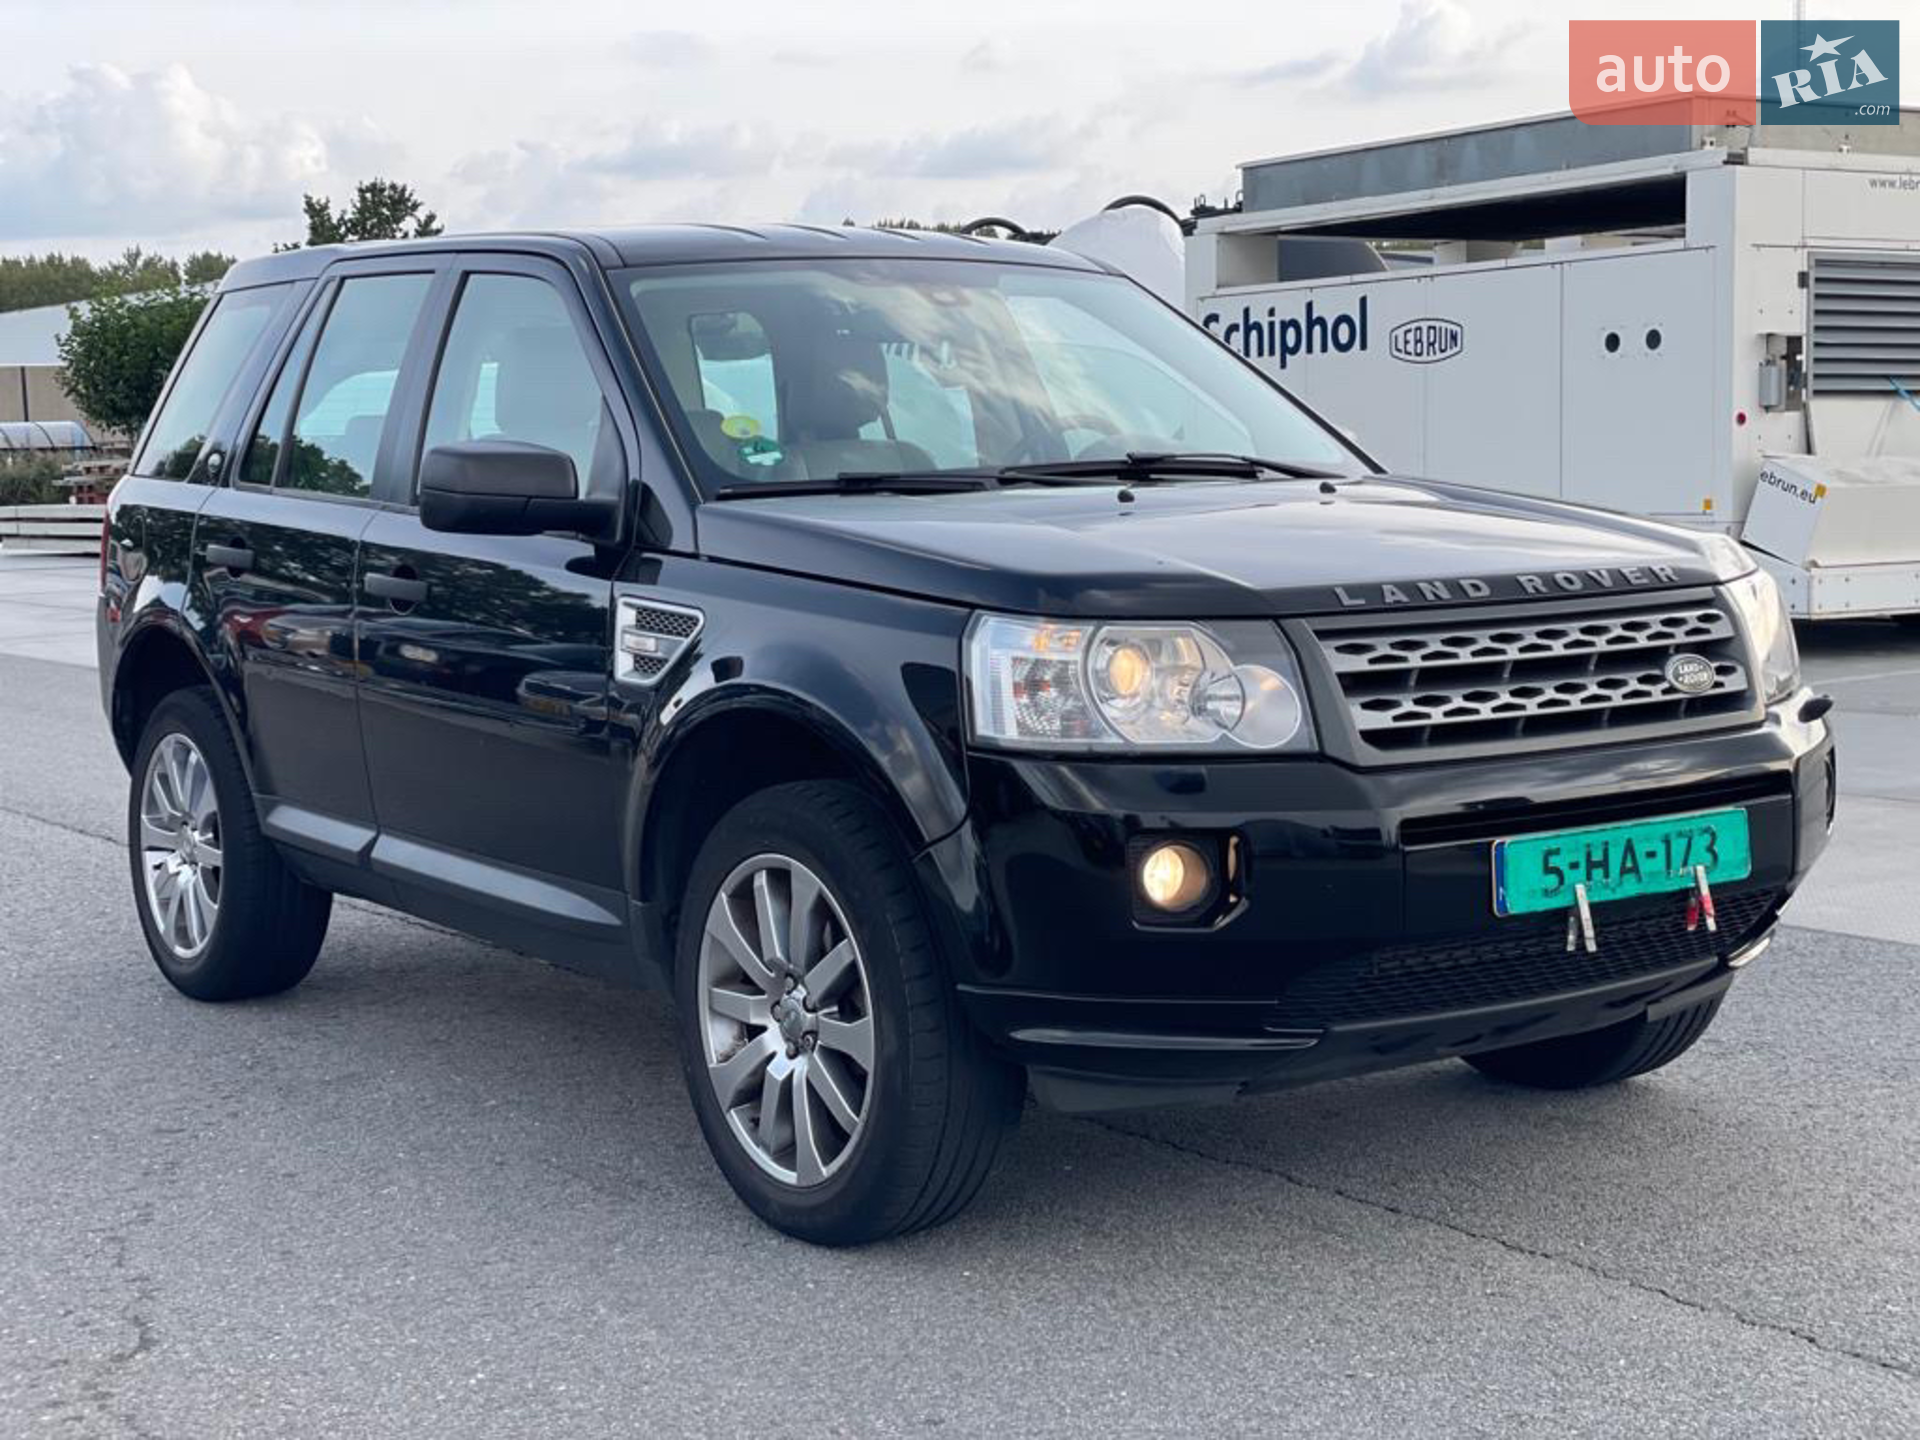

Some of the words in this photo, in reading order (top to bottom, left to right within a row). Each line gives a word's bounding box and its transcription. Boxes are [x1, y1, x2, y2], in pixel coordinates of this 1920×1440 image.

[1394, 325, 1459, 357] LEBRUN
[1334, 579, 1492, 607] LAND
[1516, 564, 1680, 595] ROVER
[1541, 824, 1719, 898] 5-HA-173
